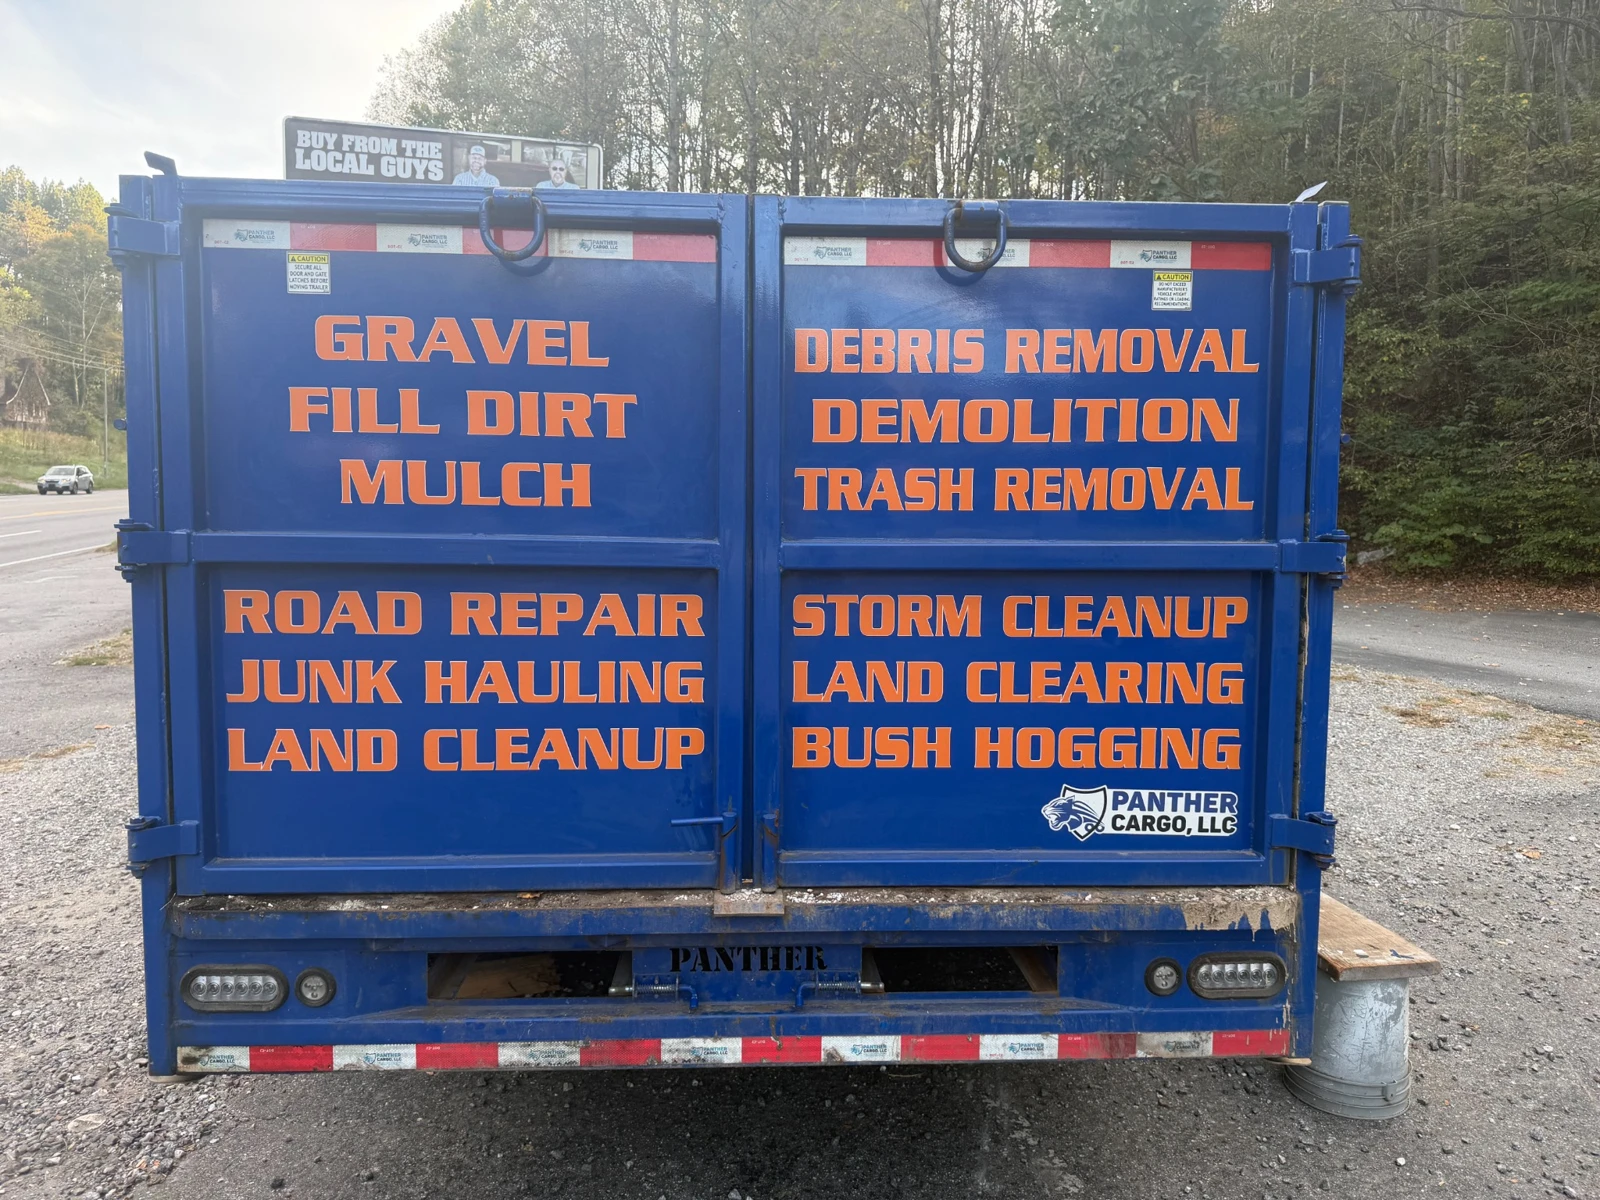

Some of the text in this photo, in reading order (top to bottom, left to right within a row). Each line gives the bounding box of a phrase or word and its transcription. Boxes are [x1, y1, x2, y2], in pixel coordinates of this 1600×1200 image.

[295, 148, 444, 181] LOCAL GUYS
[297, 130, 442, 160] BUY FROM THE
[316, 314, 610, 368] GRAVEL
[794, 328, 1260, 375] DEBRIS REMOVAL
[289, 387, 638, 439] FILL DIRT
[811, 398, 1240, 444] DEMOLITION
[340, 460, 592, 508] MULCH
[795, 467, 1254, 513] TRASH REMOVAL
[224, 590, 705, 639] ROAD REPAIR
[793, 595, 1250, 640] STORM CLEANUP
[226, 659, 705, 705] JUNK HAULING
[793, 661, 1245, 706] LAND CLEARING
[228, 727, 706, 773] LAND CLEANUP
[792, 727, 1242, 771] BUSH HOGGING
[1111, 791, 1236, 813] PANTHER
[1111, 814, 1236, 835] CARGO, LLC
[670, 945, 828, 972] PANTHER
